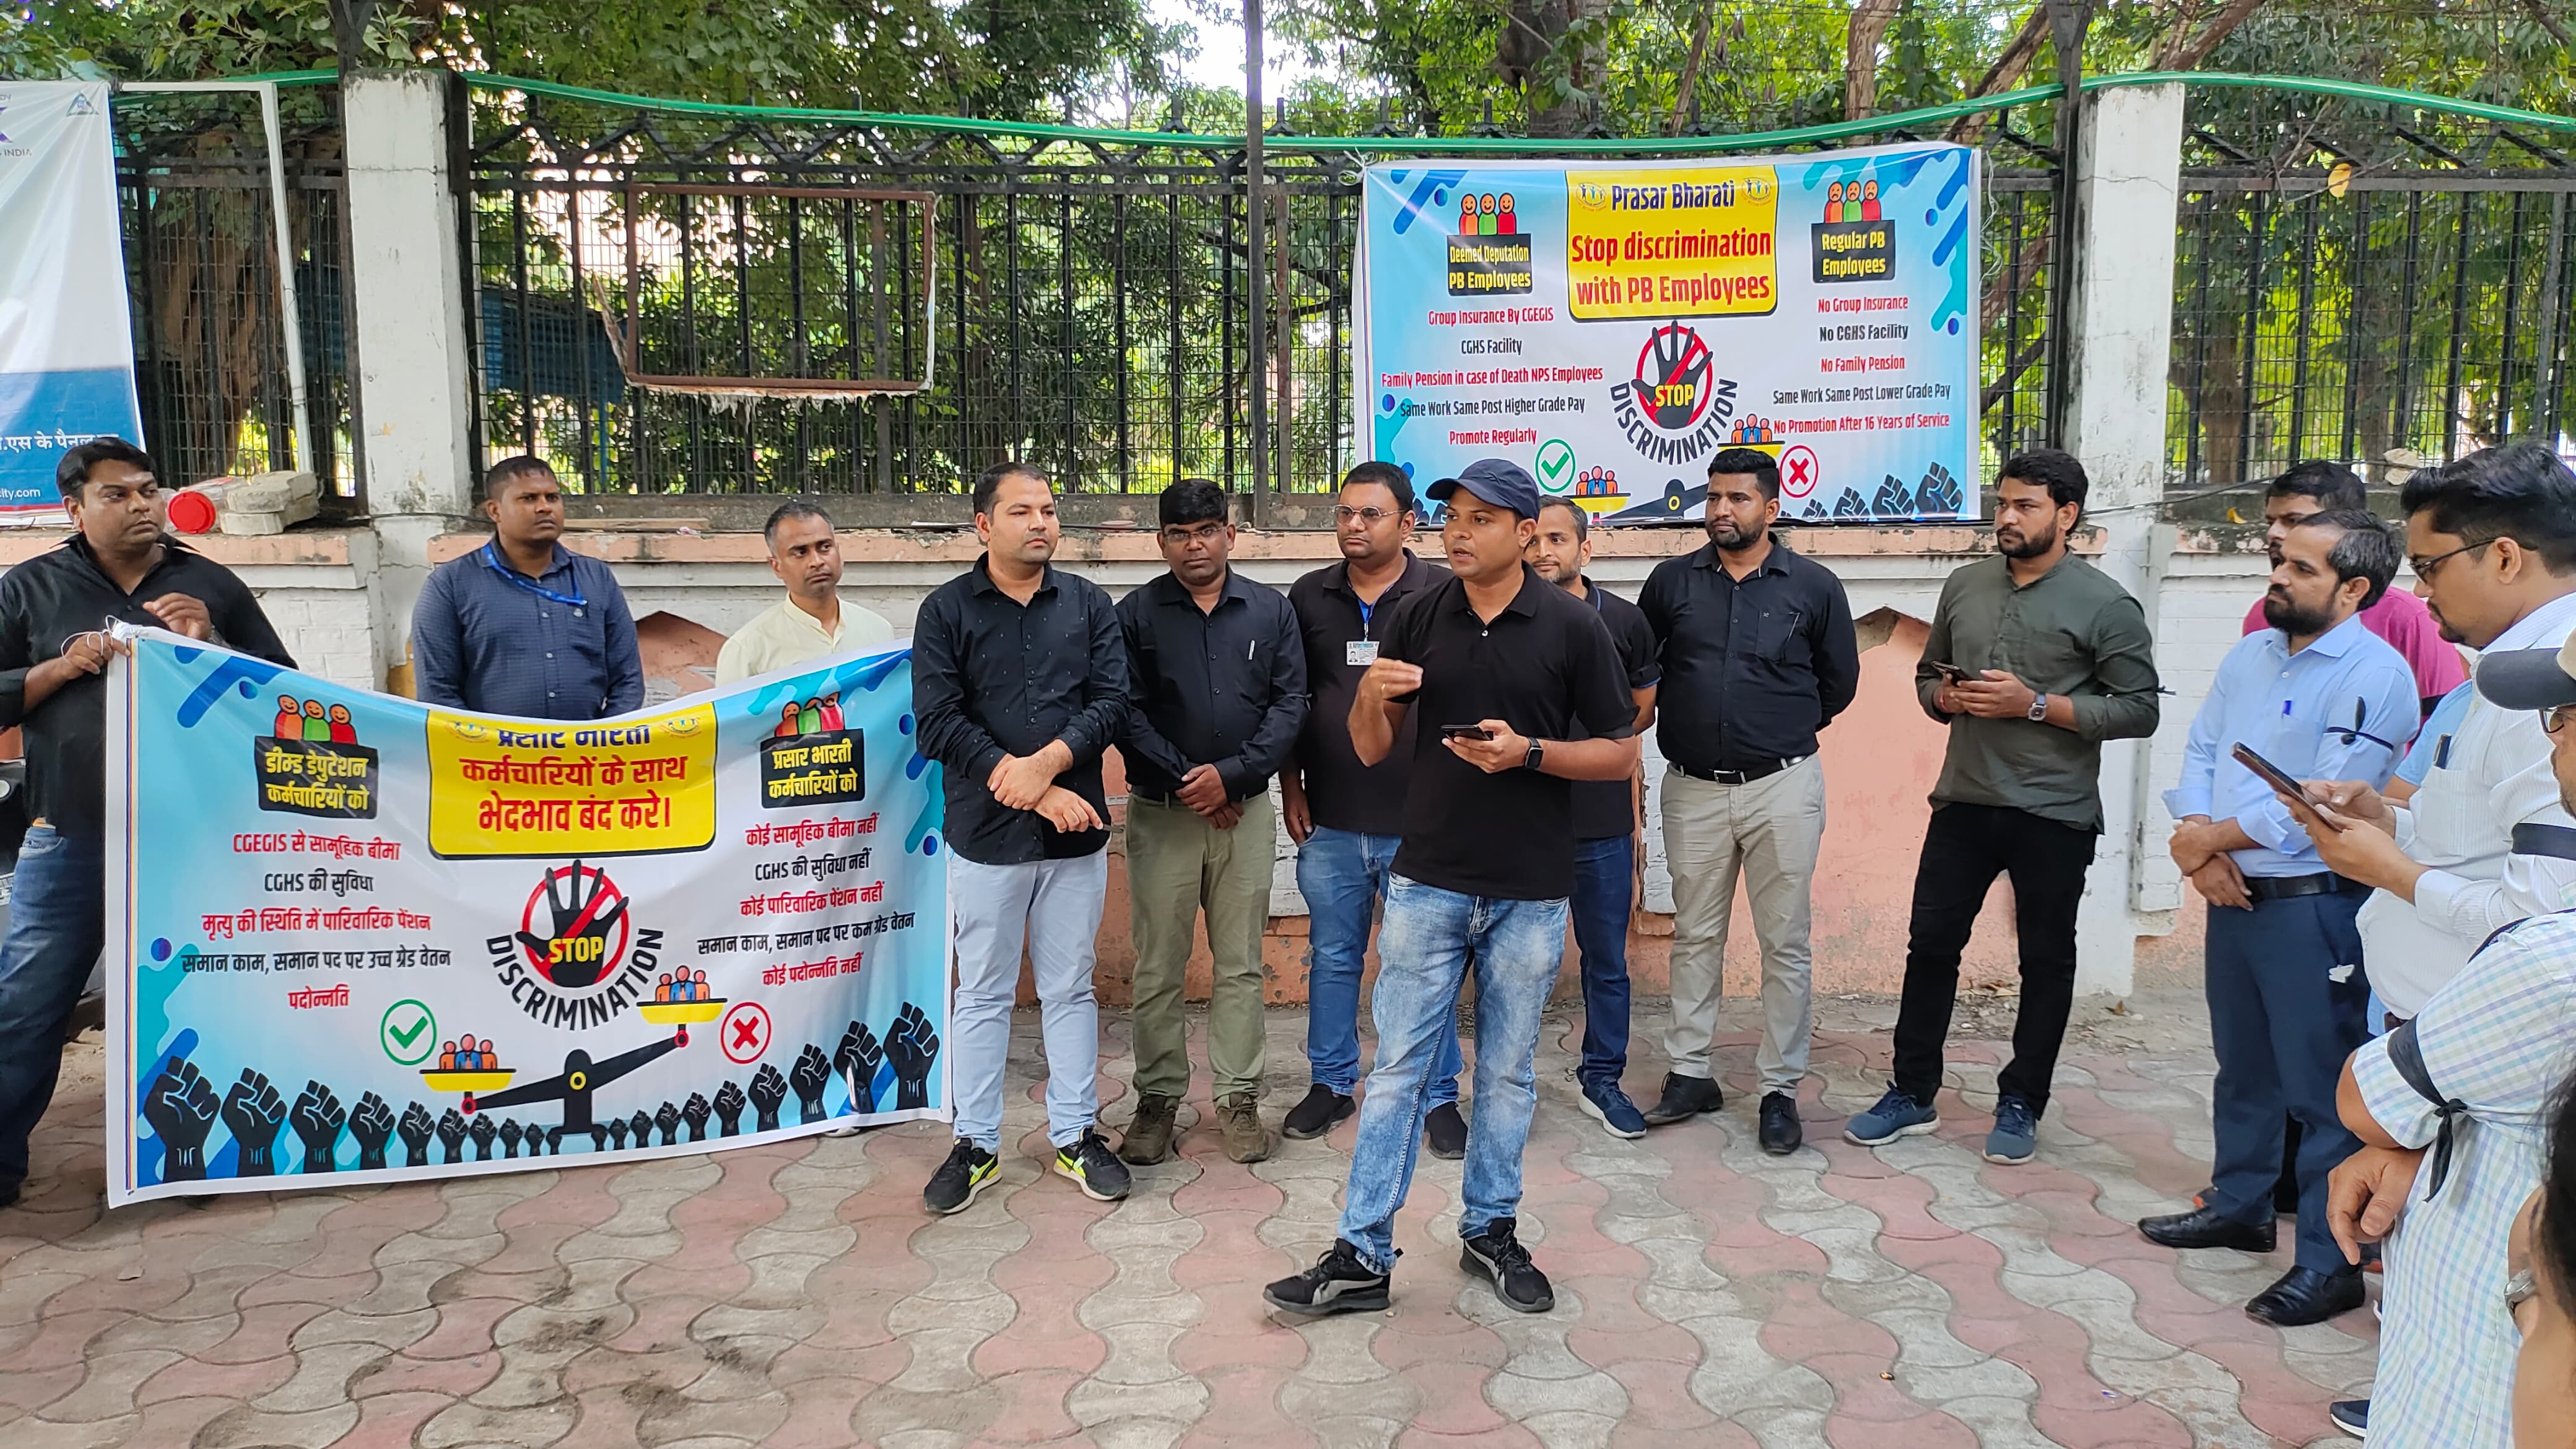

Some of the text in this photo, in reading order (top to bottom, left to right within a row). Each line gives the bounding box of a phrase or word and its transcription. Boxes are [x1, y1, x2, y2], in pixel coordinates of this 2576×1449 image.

[4, 149, 32, 157] INDIA
[1611, 184, 1667, 211] Prasar
[1672, 180, 1735, 209] Bharati
[1450, 244, 1530, 264] Deemed Deputation
[1572, 227, 1771, 267] Stop discrimination
[1822, 232, 1886, 253] Regular PB
[1822, 257, 1886, 277] Employees
[1449, 271, 1531, 292] PB Employees
[1577, 273, 1770, 307] with PB Employees
[1429, 307, 1554, 327] Group Insurance By CGEGIS
[1818, 296, 1908, 315] No Group Insurance
[1820, 323, 1908, 341] No CGHS Facility
[1461, 338, 1523, 355] CGHS Facility
[1382, 366, 1603, 389] Family Pension in case of Death NPS Employees
[1821, 355, 1905, 373] No Family Pension
[1400, 396, 1585, 417] Same Work Same Post Higher Grade Pay
[1655, 384, 1694, 407] STOP
[1773, 383, 1951, 404] Same Work Same Post Lower Grade Pay
[1450, 427, 1537, 445] Promote Regularly
[1611, 378, 1738, 466] DISCRIMINATION
[1774, 412, 1950, 433] No Promotion After 16 Years of Service
[0, 437, 32, 453] .एस
[34, 431, 53, 450] के
[0, 487, 41, 500] ity.com
[264, 746, 369, 782] डीम्ड डेपुटेशन
[772, 738, 852, 770] प्रसार भारती
[459, 754, 689, 786] कर्मचारियों के साथ
[768, 768, 858, 798] कर्मचारियों को
[265, 780, 370, 810] कर्मचारियों को
[479, 790, 572, 832] भेदभाव
[577, 793, 614, 831] बंद
[746, 812, 880, 848] कोई सामूहिक बीमा नहीं
[233, 829, 401, 860] CGEGIS से सामूहिक बीमा
[755, 847, 872, 881] CGHS की सुविधा नहीं
[264, 868, 374, 897] CGHS की सुविधा
[740, 880, 885, 916] कोई पारिवारिक पेंशन नहीं
[201, 906, 431, 941] मृत्यु की स्थिति में पारिवारिक पेंशन
[697, 912, 915, 955] समान काम, समान पद पर कम ग्रेड वेतन
[181, 943, 451, 975] समान काम, समान पद पर उच्च ग्रेड वेतन
[549, 936, 603, 964] STOP
[486, 928, 664, 1031] DISCRIMINATION
[763, 952, 864, 986] कोई पदोन्नति नहीं
[288, 983, 350, 1009] पदोन्नति
